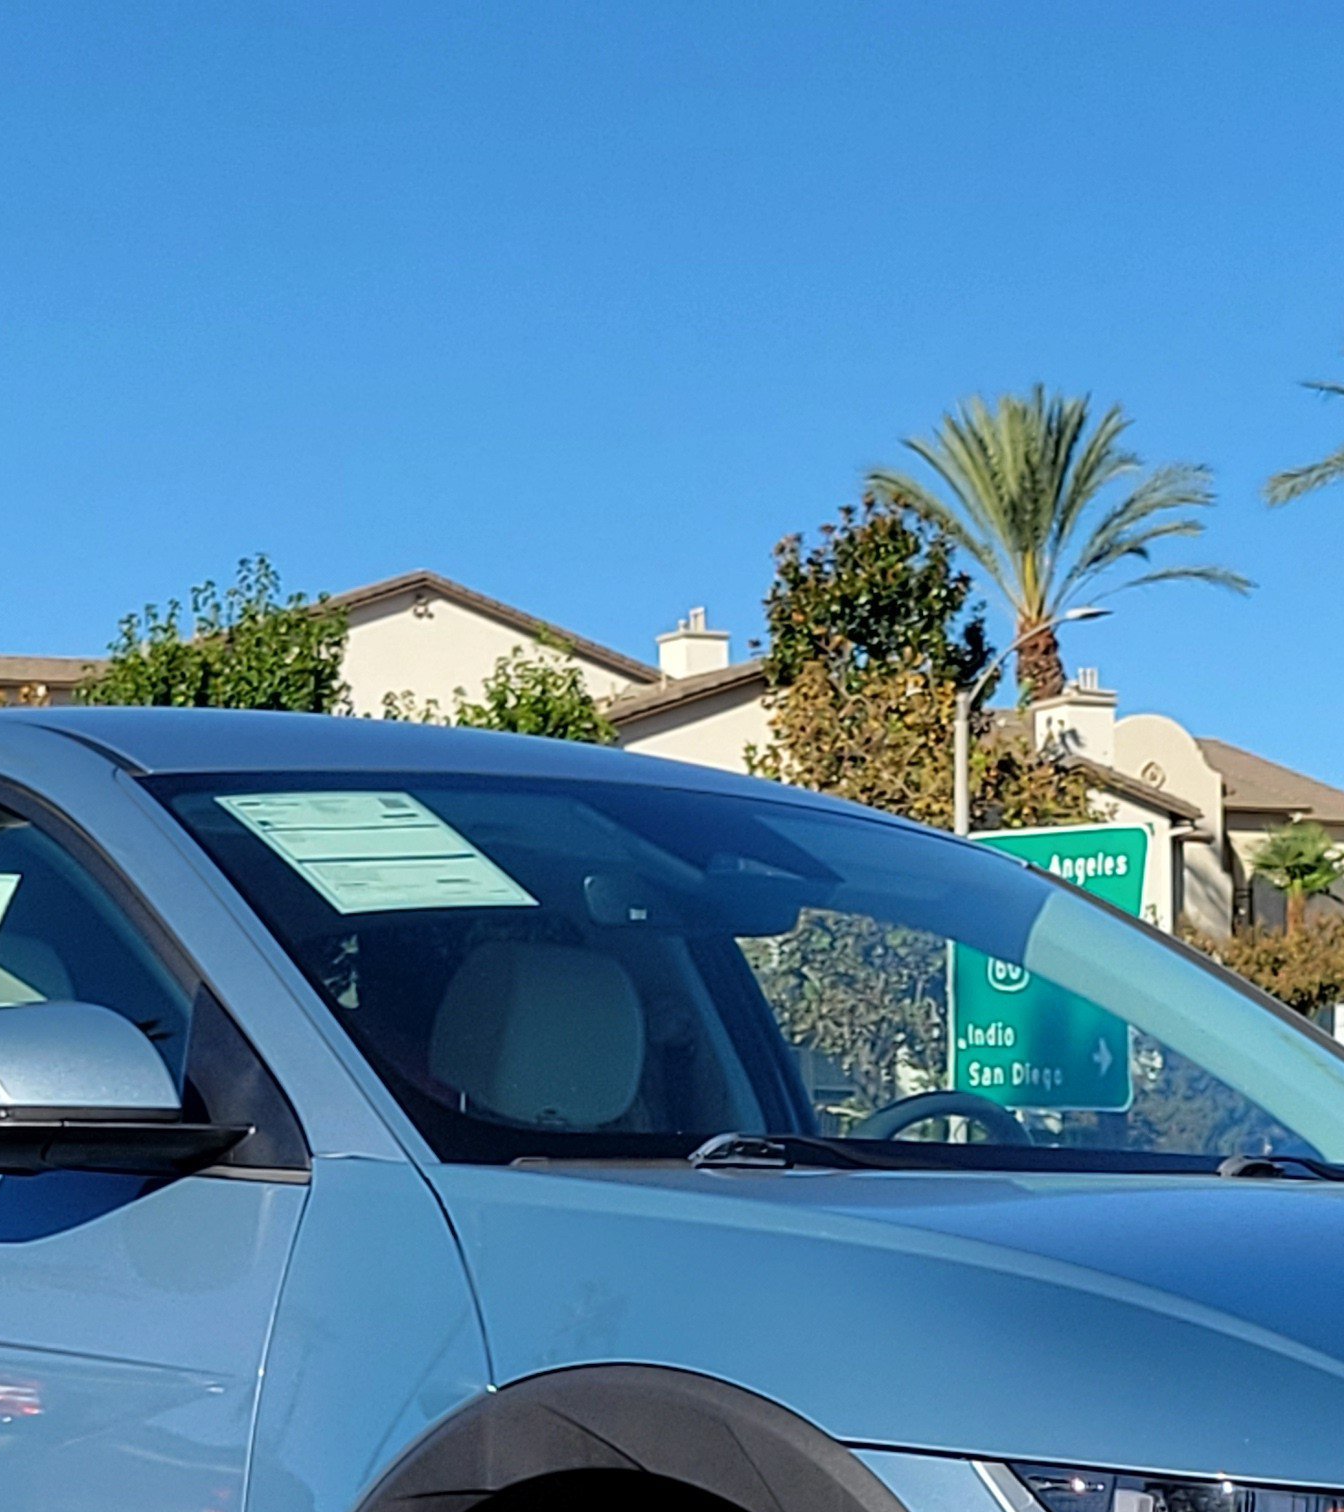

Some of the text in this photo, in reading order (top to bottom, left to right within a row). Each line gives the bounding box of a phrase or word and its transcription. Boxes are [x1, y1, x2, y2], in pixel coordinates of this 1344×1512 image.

[1048, 851, 1128, 887] Angeles
[967, 1022, 1015, 1047] Indio
[968, 1061, 1064, 1092] San Diego
